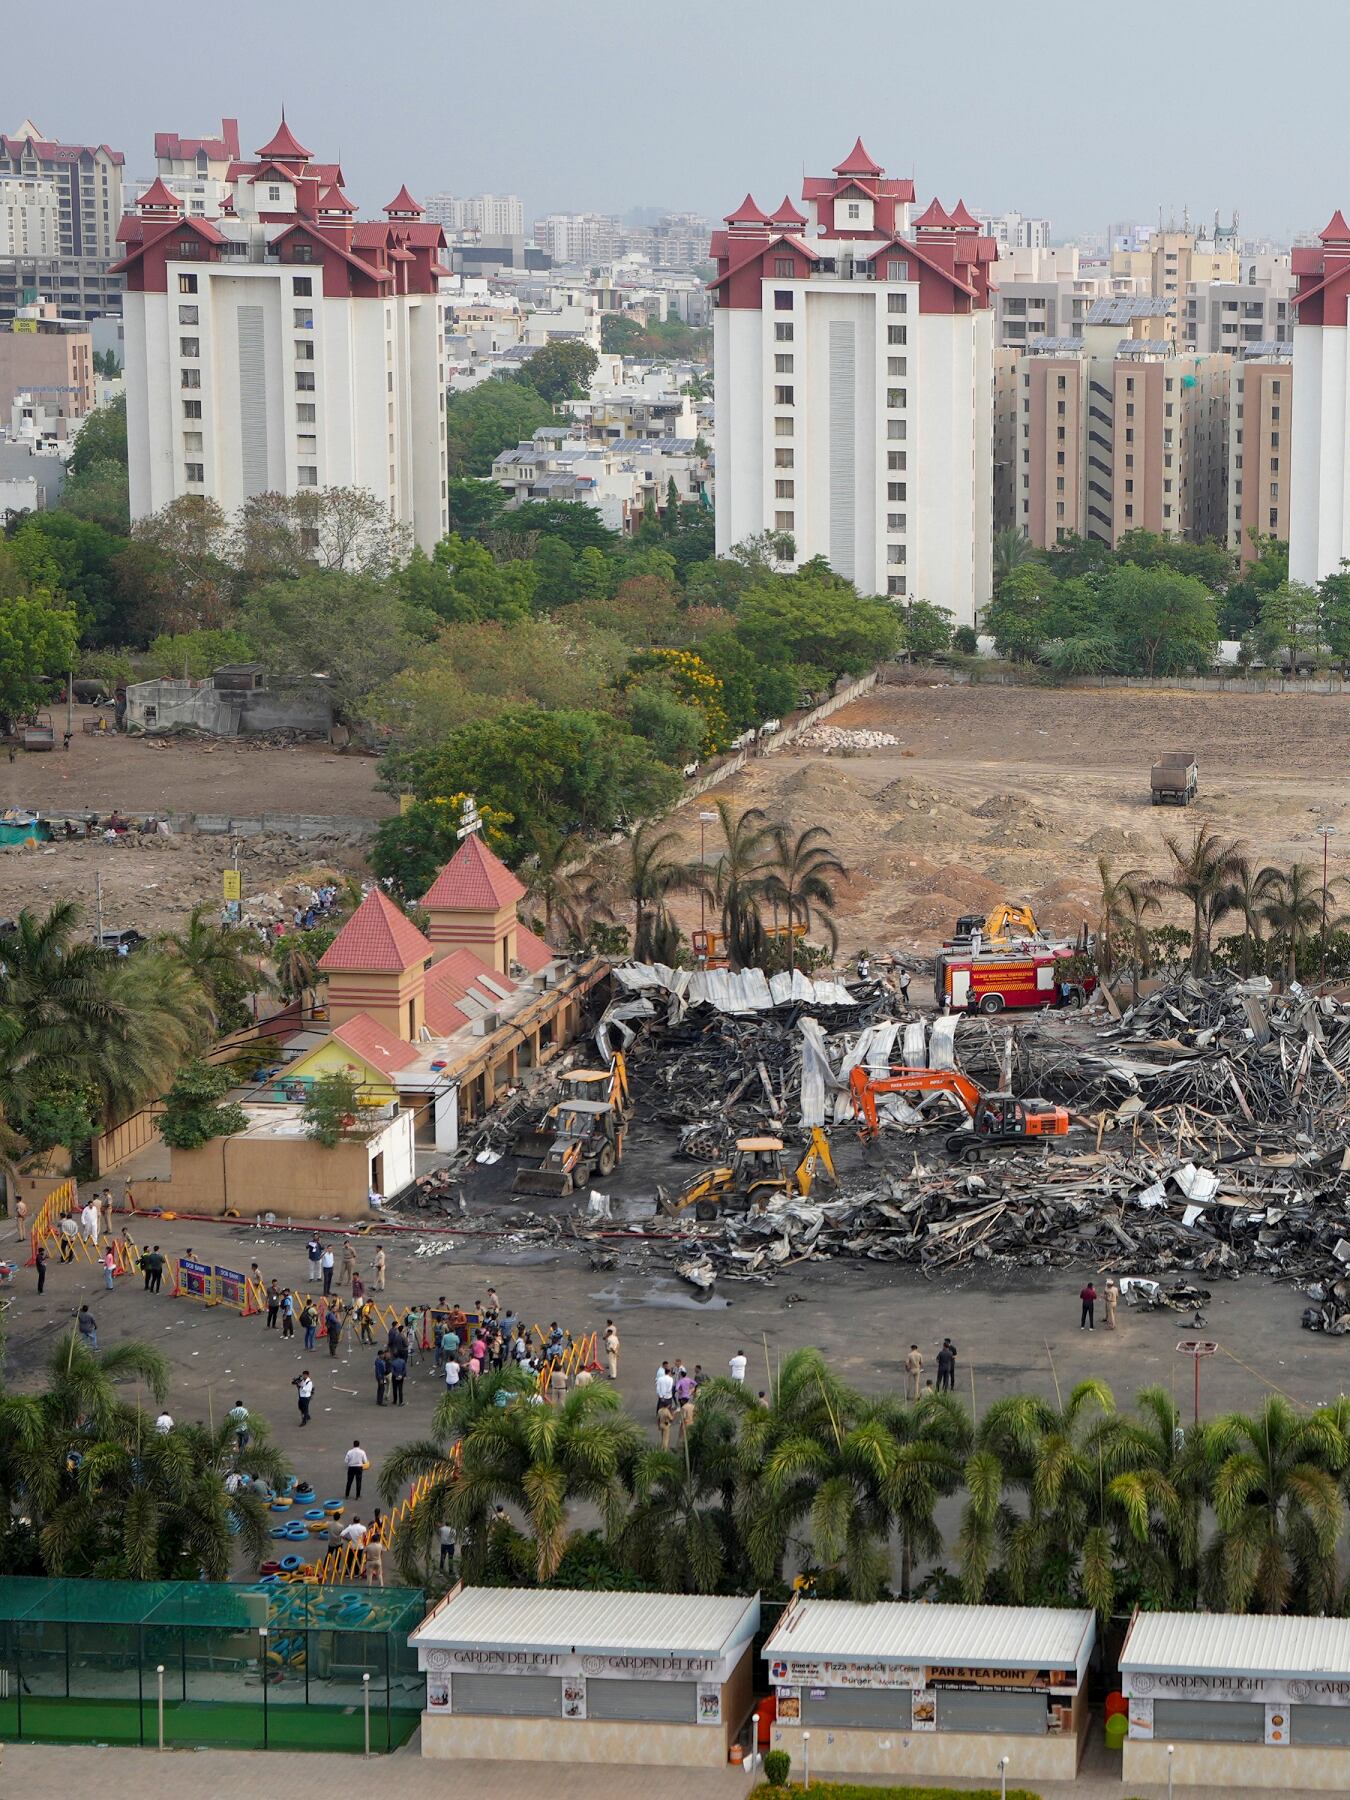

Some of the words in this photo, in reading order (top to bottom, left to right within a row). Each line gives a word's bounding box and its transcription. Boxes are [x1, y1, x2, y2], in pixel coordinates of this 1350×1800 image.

[454, 1651, 505, 1662] GARDEN
[508, 1652, 561, 1665] DELIGHT
[608, 1657, 659, 1669] GARDEN
[662, 1659, 713, 1671] DELIGHT
[824, 1661, 847, 1672] Pizza
[851, 1662, 886, 1673] Sandwich
[931, 1667, 955, 1677] PAN
[959, 1668, 966, 1677] &
[969, 1668, 990, 1678] TEA
[993, 1669, 1026, 1679] POINT
[841, 1676, 872, 1686] Burger
[1159, 1676, 1208, 1688] GARDEN
[1212, 1678, 1264, 1690] DELIGHT
